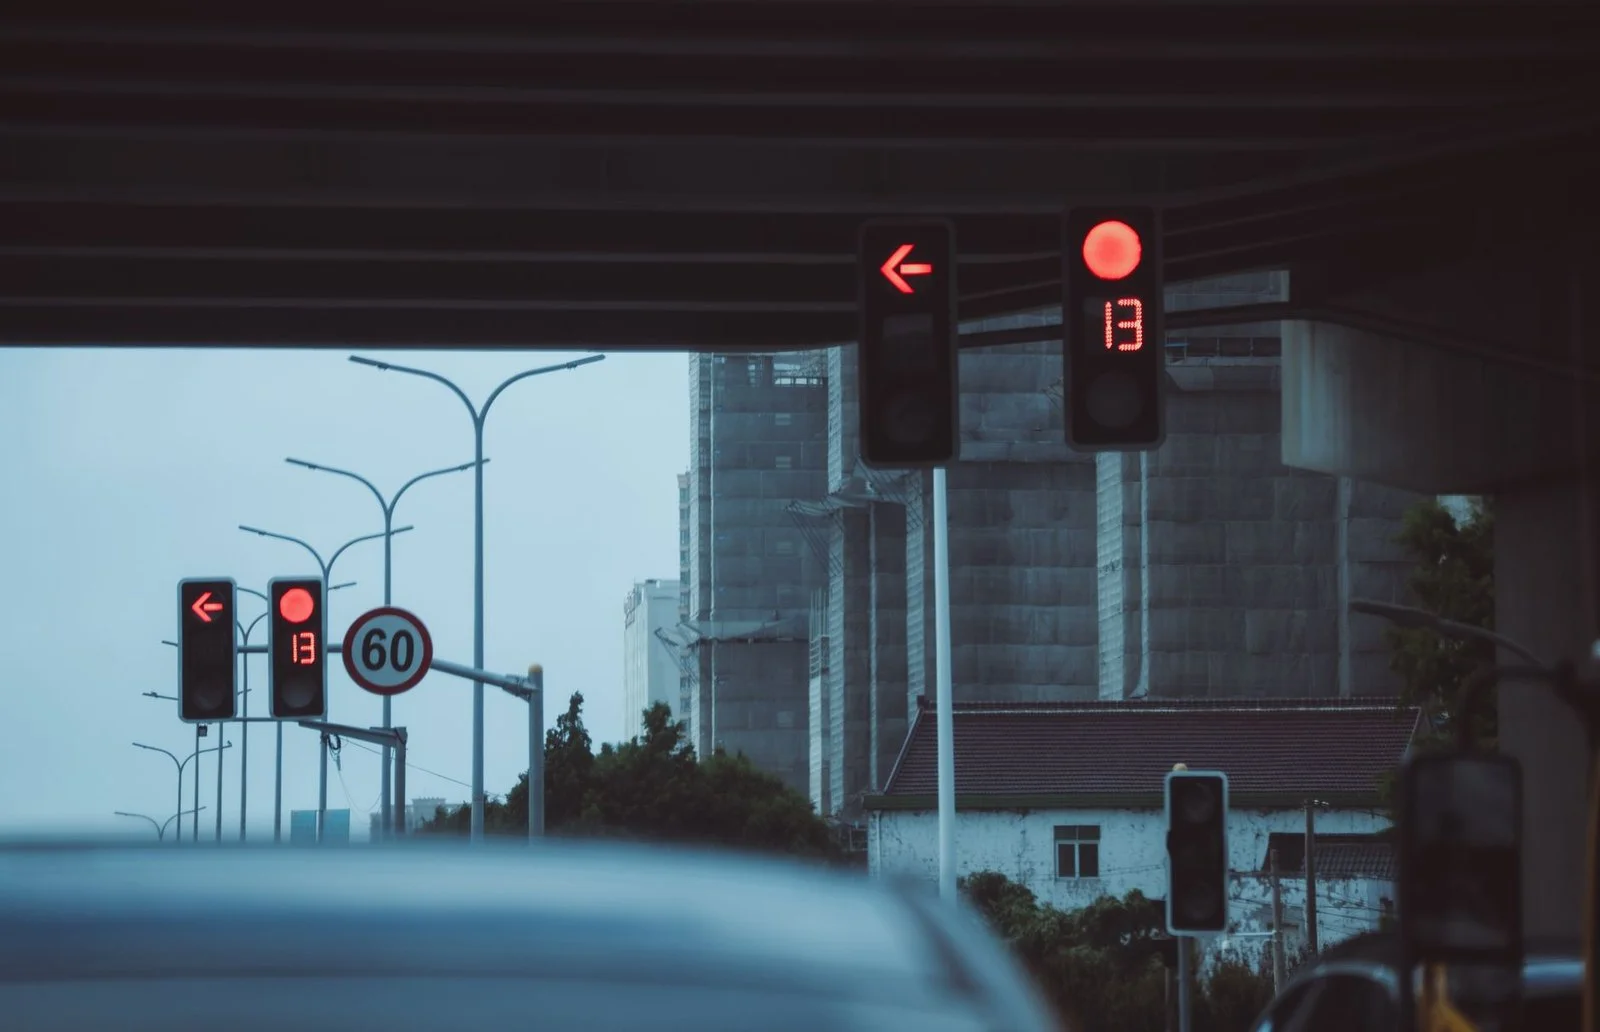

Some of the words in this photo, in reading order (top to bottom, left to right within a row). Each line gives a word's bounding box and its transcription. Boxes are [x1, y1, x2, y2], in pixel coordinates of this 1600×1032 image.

[1104, 297, 1143, 352] 13
[292, 631, 316, 665] 13
[361, 627, 415, 673] 60
